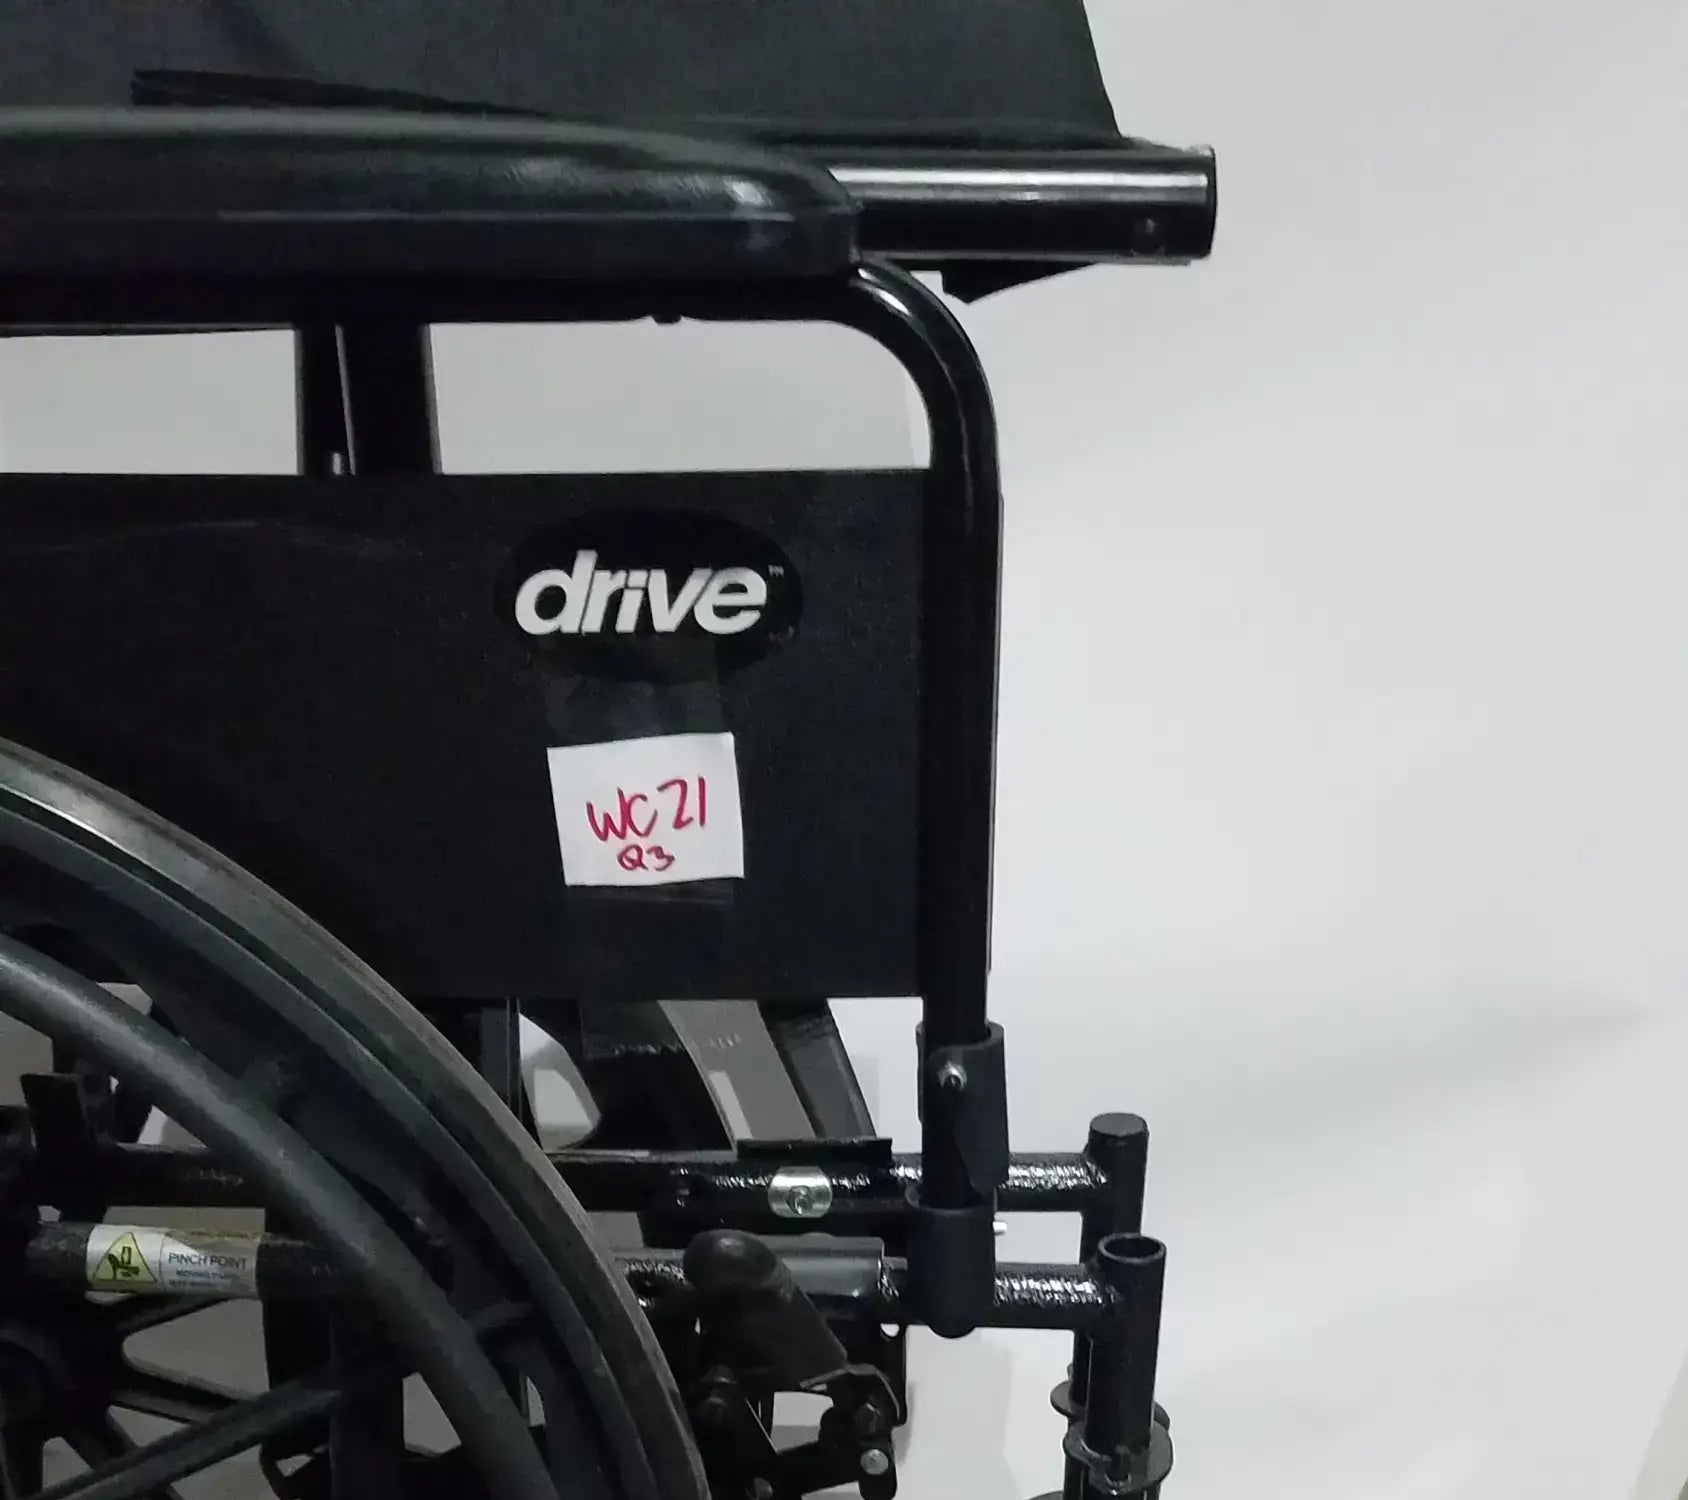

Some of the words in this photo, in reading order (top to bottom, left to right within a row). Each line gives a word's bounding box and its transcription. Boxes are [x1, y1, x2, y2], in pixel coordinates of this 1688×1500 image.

[515, 550, 767, 635] drive
[617, 844, 675, 871] Q3
[168, 1252, 207, 1266] PINCH
[210, 1255, 248, 1269] POINT
